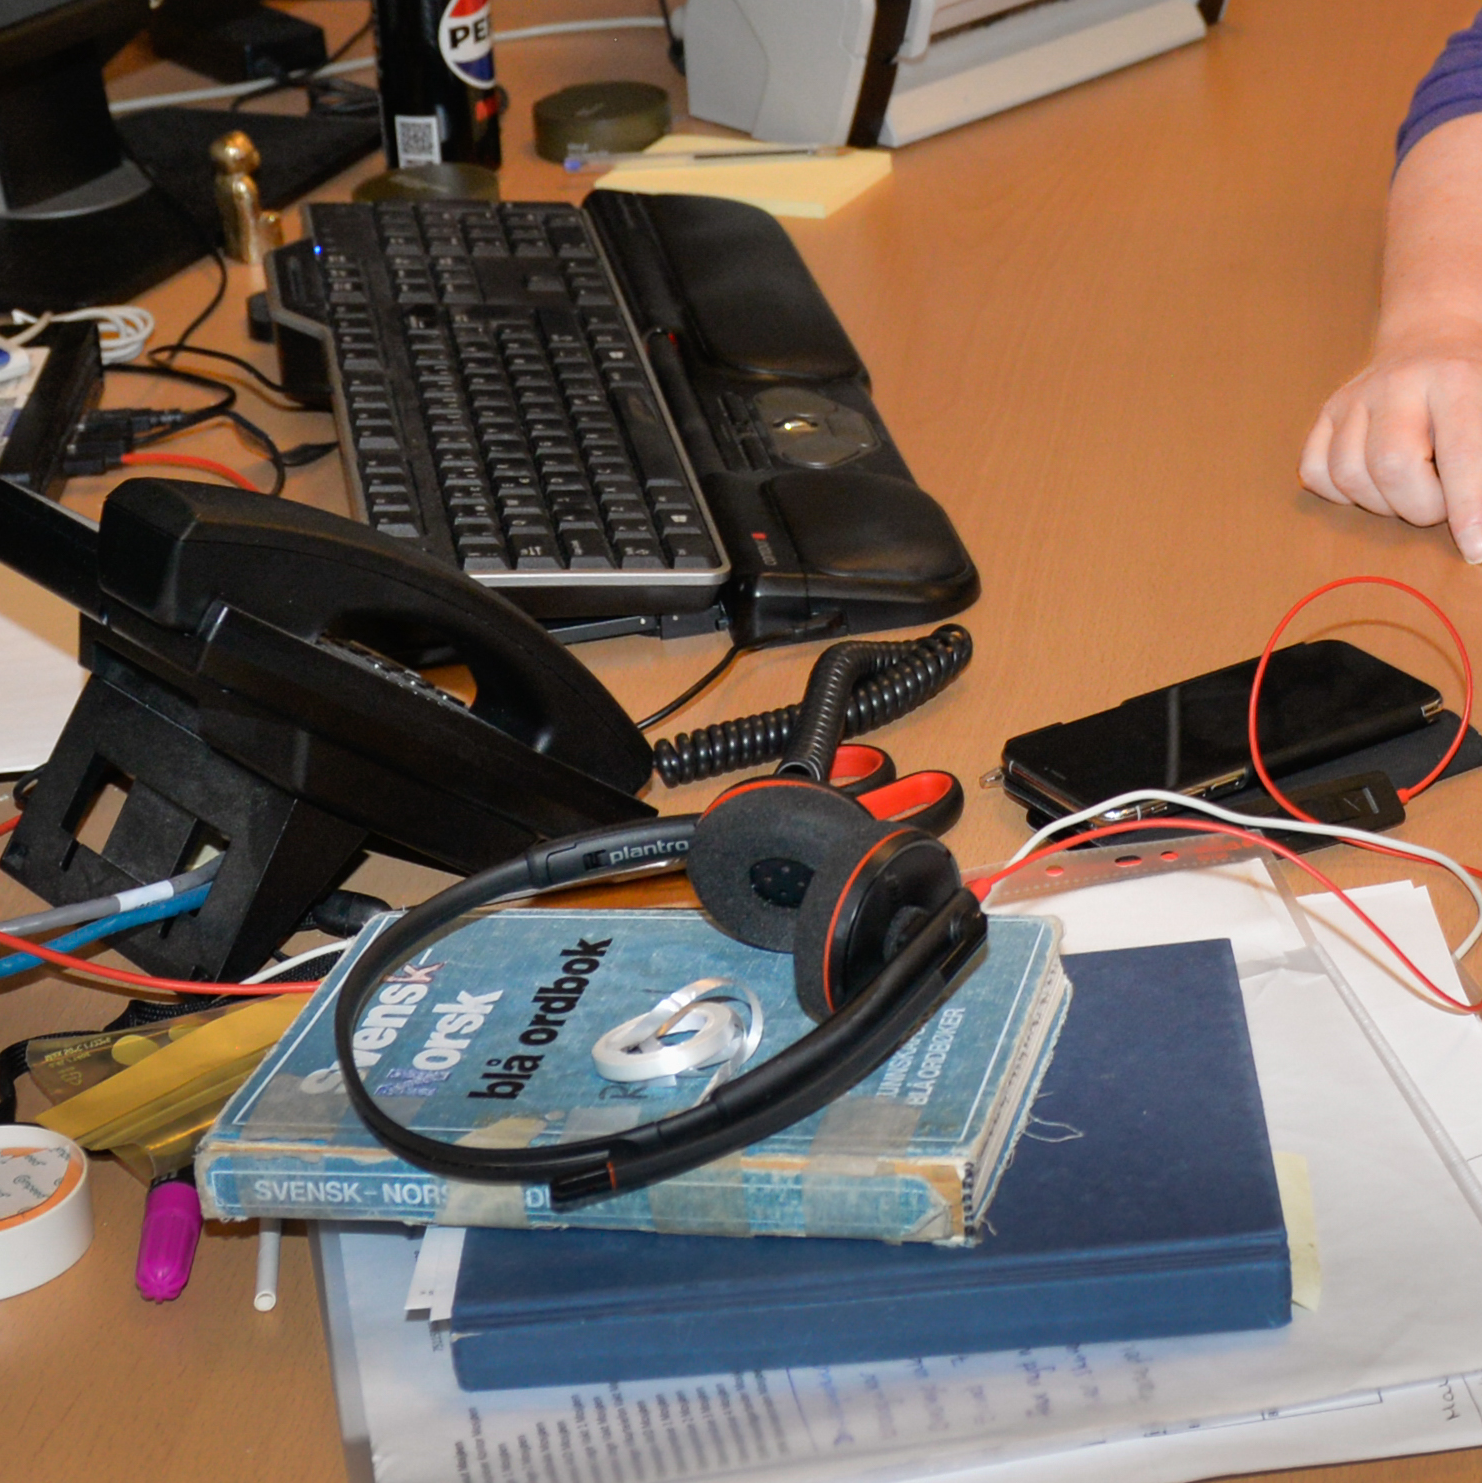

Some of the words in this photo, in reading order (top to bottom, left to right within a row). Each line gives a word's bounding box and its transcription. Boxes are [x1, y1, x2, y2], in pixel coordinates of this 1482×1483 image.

[449, 17, 490, 50] PE
[609, 839, 690, 865] plantro
[467, 1055, 544, 1100] blå
[519, 937, 613, 1046] ordbok
